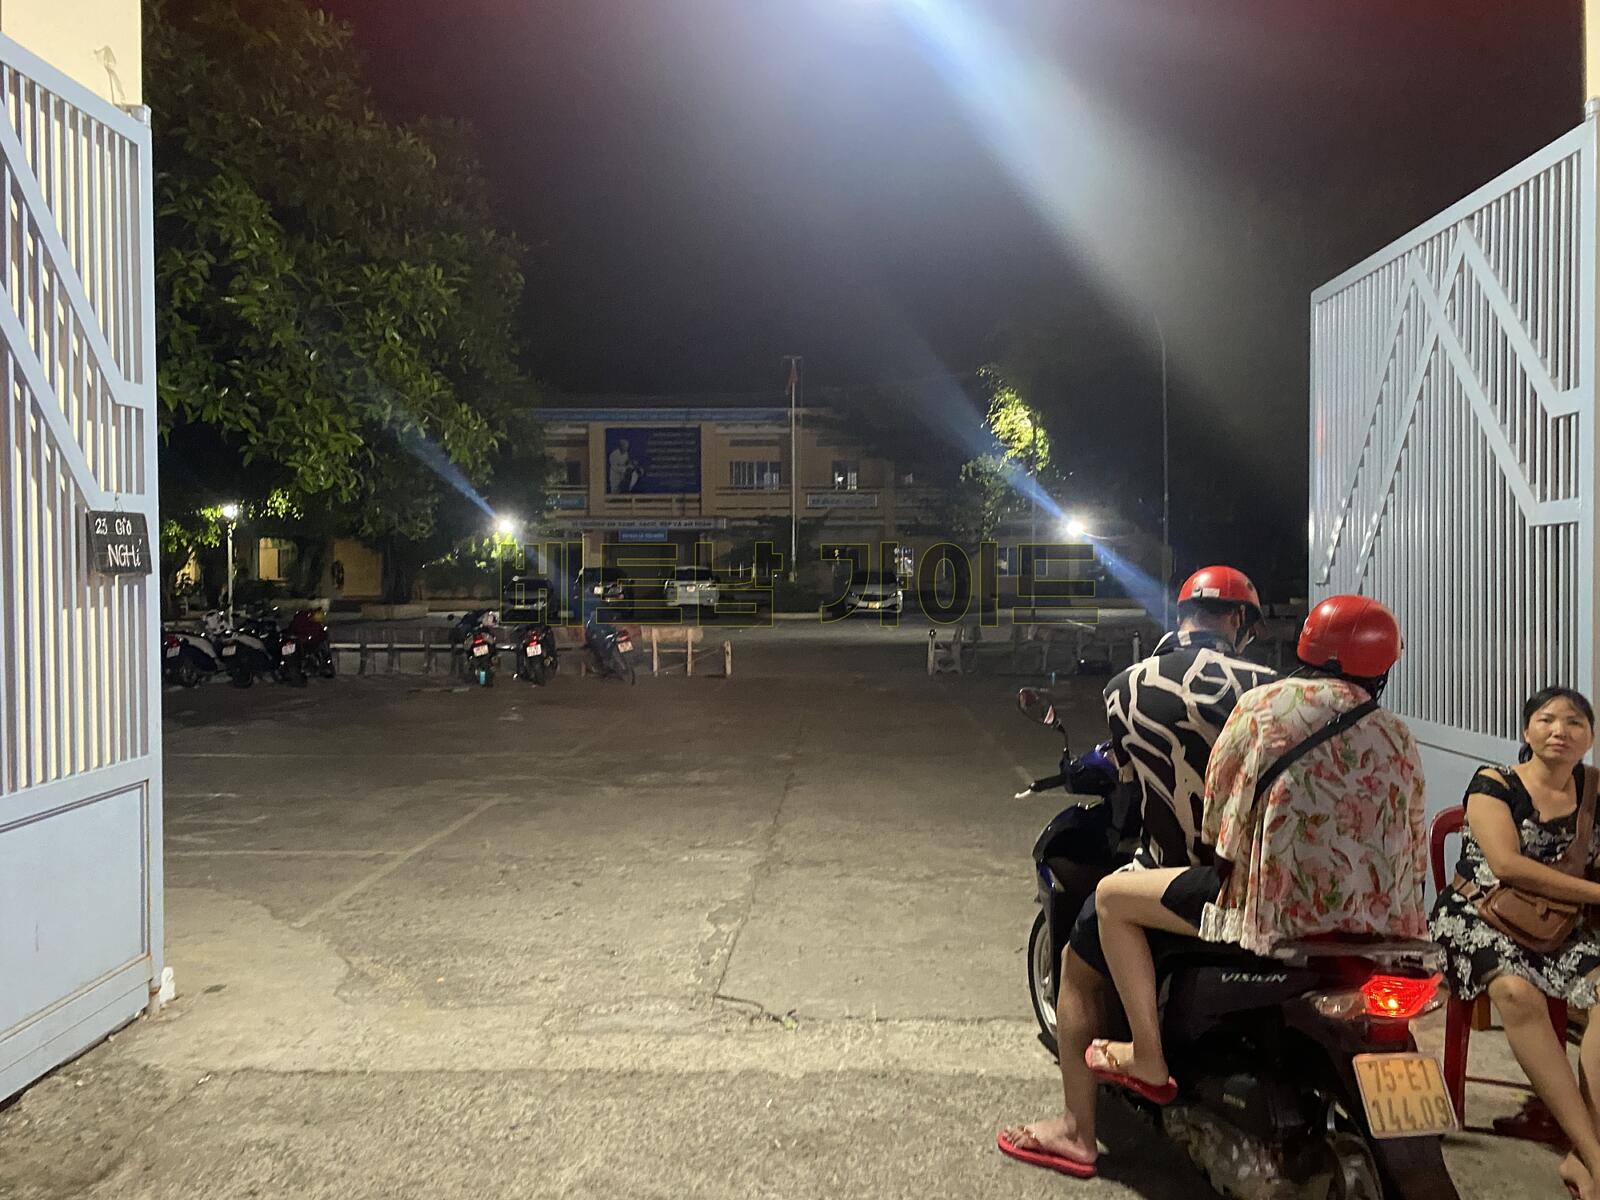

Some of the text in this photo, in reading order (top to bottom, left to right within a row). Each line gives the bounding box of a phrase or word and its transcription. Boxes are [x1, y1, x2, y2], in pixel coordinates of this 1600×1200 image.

[95, 517, 108, 535] 23
[1221, 973, 1288, 983] VISION
[1367, 1060, 1431, 1093] 75-E1
[1372, 1096, 1450, 1132] 144.09
